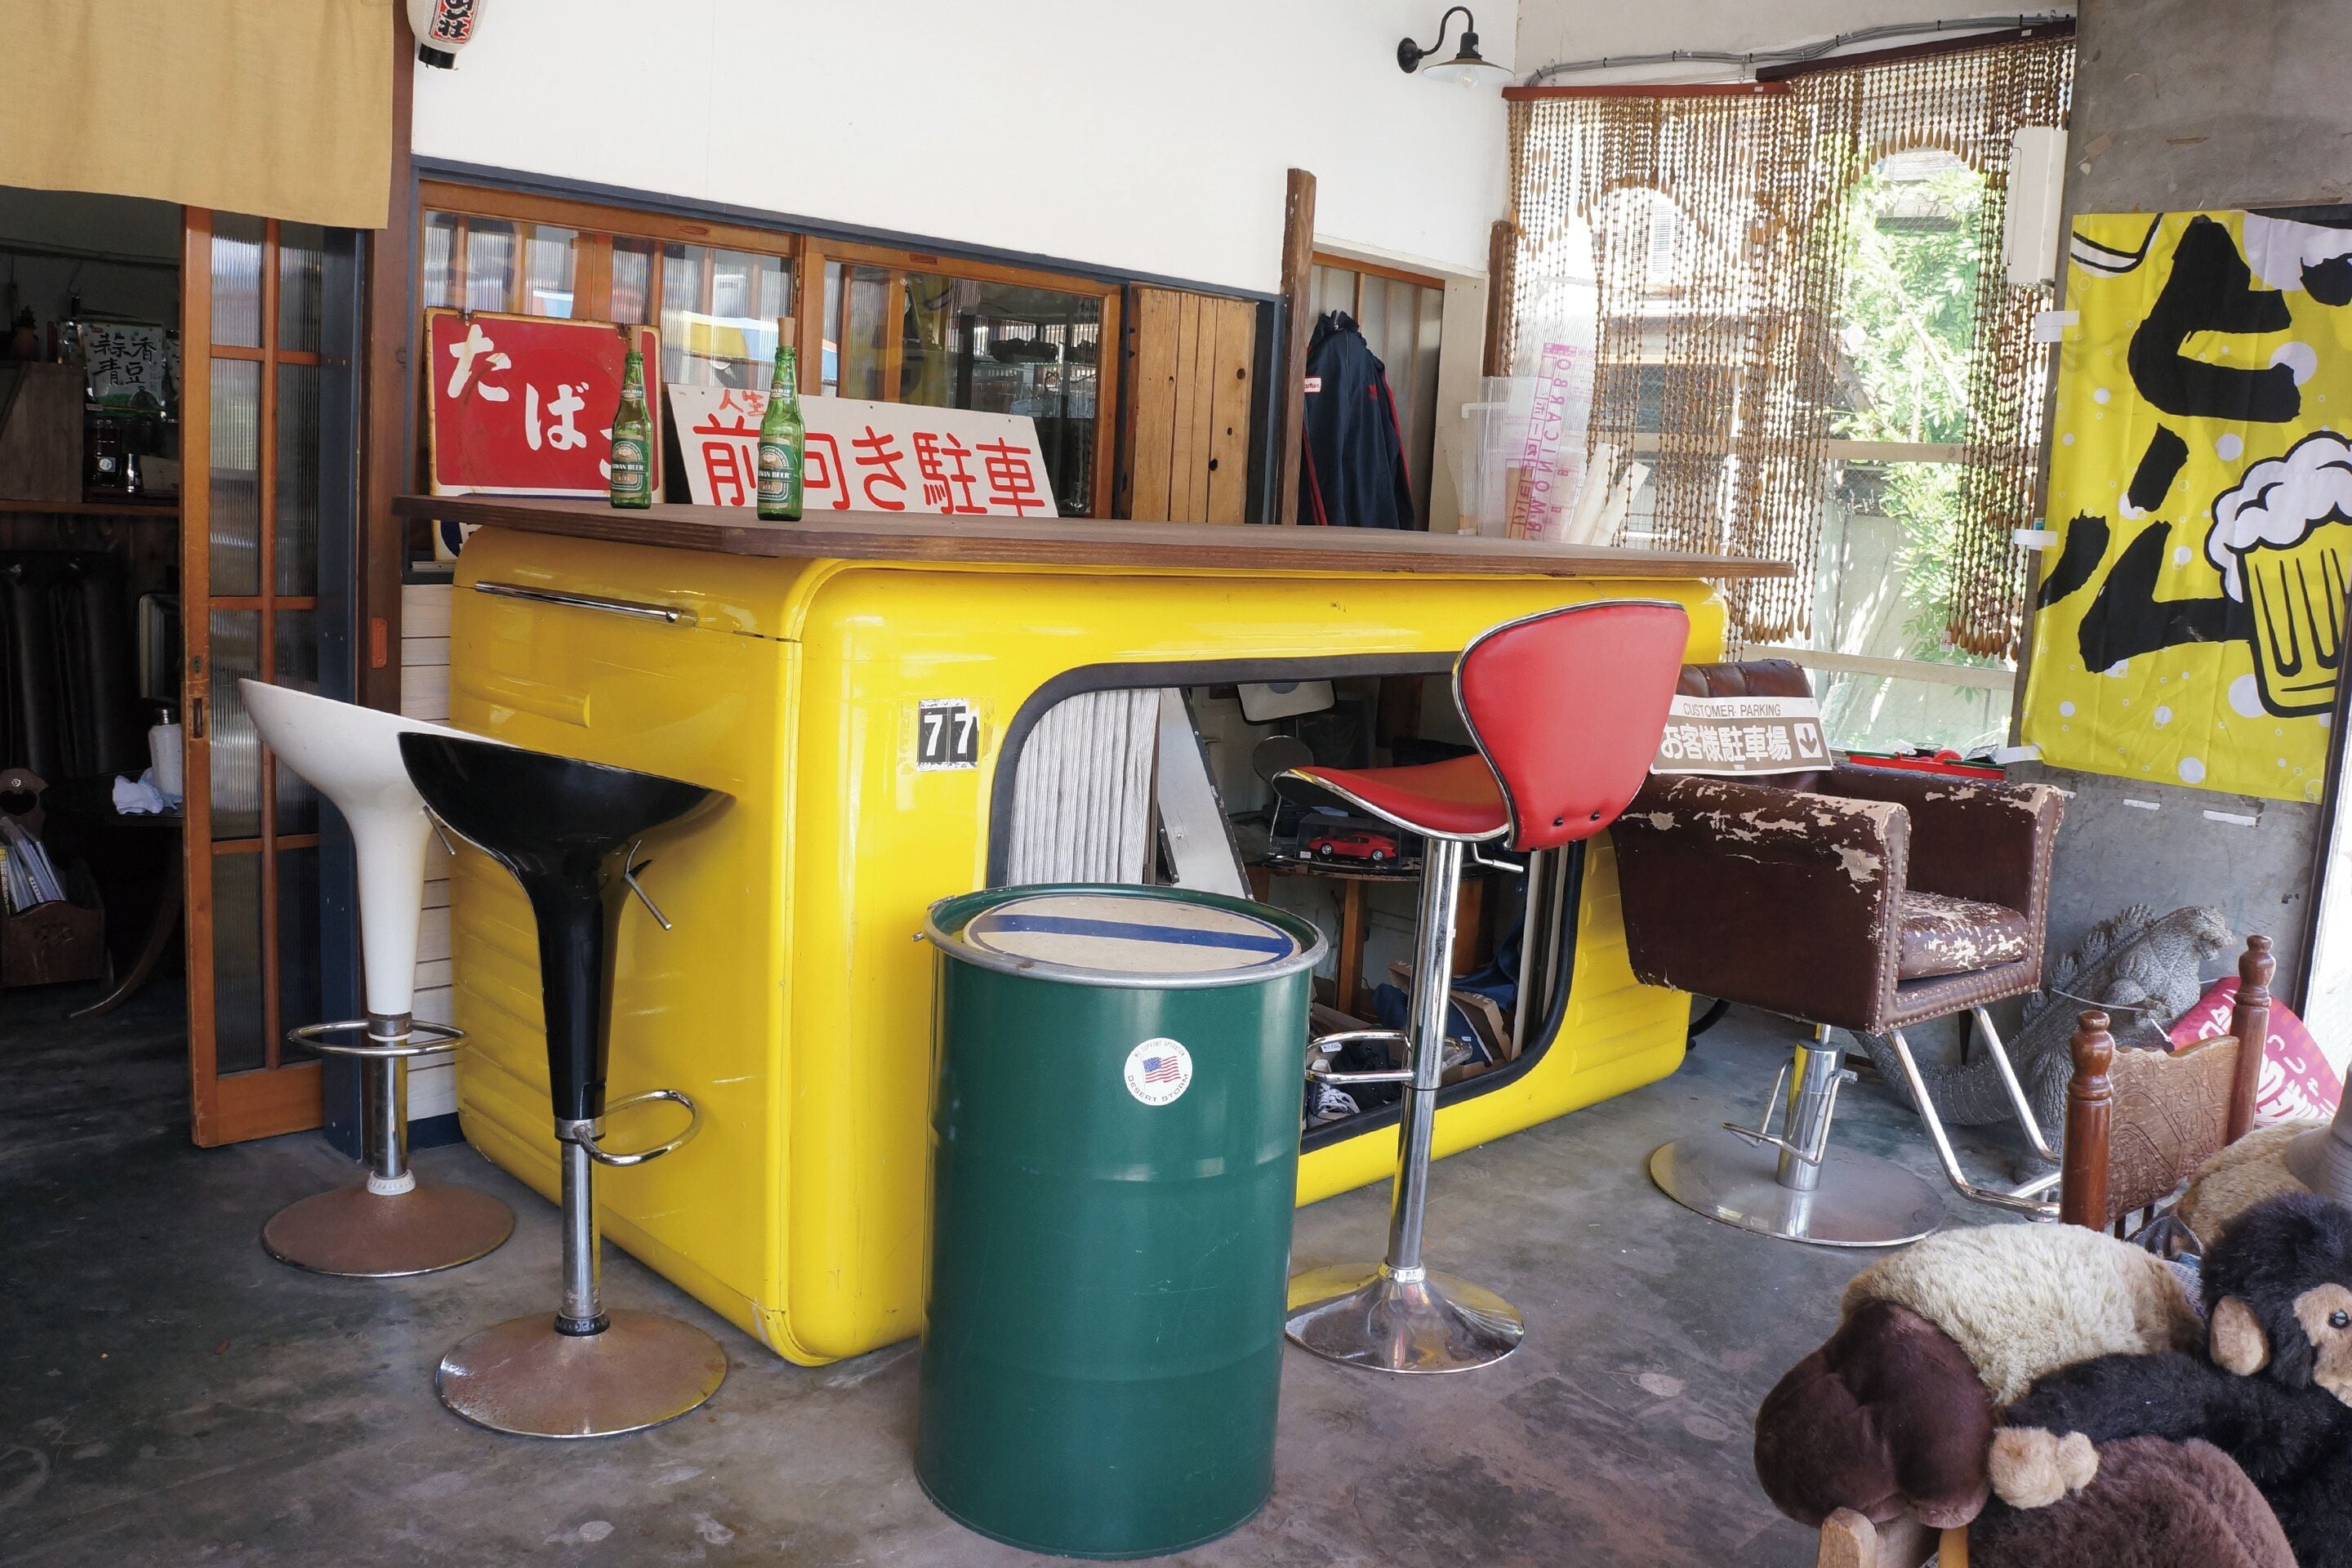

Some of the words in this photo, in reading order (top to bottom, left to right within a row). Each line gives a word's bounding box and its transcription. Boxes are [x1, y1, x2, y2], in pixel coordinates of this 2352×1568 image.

[91, 358, 145, 386] 青豆
[719, 388, 765, 416] 人生
[1683, 702, 1735, 717] CUSTOMER
[1740, 703, 1781, 716] PARKING
[924, 712, 973, 756] 77
[1660, 723, 1793, 762] お客様駐車場
[1128, 1075, 1157, 1102] DESERT
[1161, 1073, 1189, 1102] STORM
